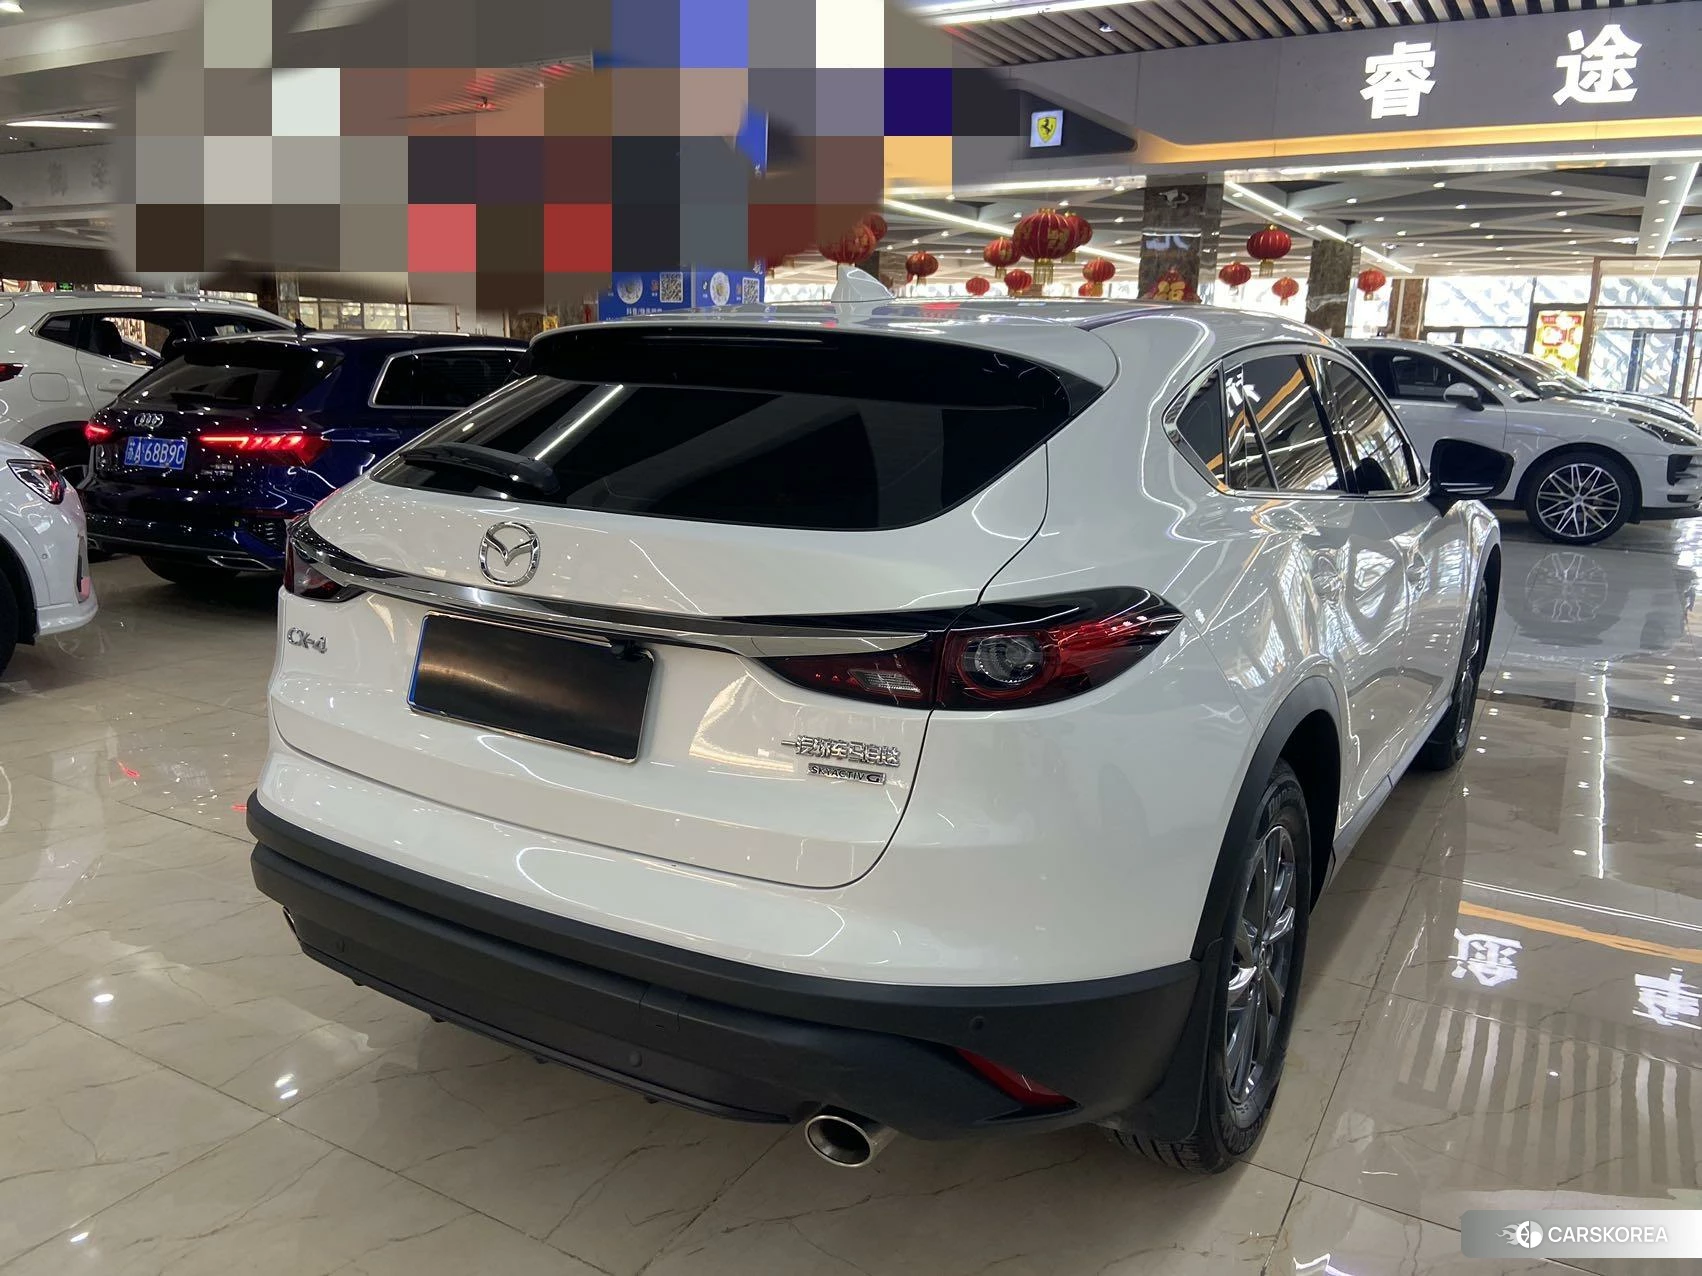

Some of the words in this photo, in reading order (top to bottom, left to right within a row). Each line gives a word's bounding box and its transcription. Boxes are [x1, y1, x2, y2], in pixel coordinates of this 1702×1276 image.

[287, 626, 328, 654] CX-4
[781, 735, 900, 767] 一汽轿车马自达
[810, 765, 865, 781] SKYACTIV
